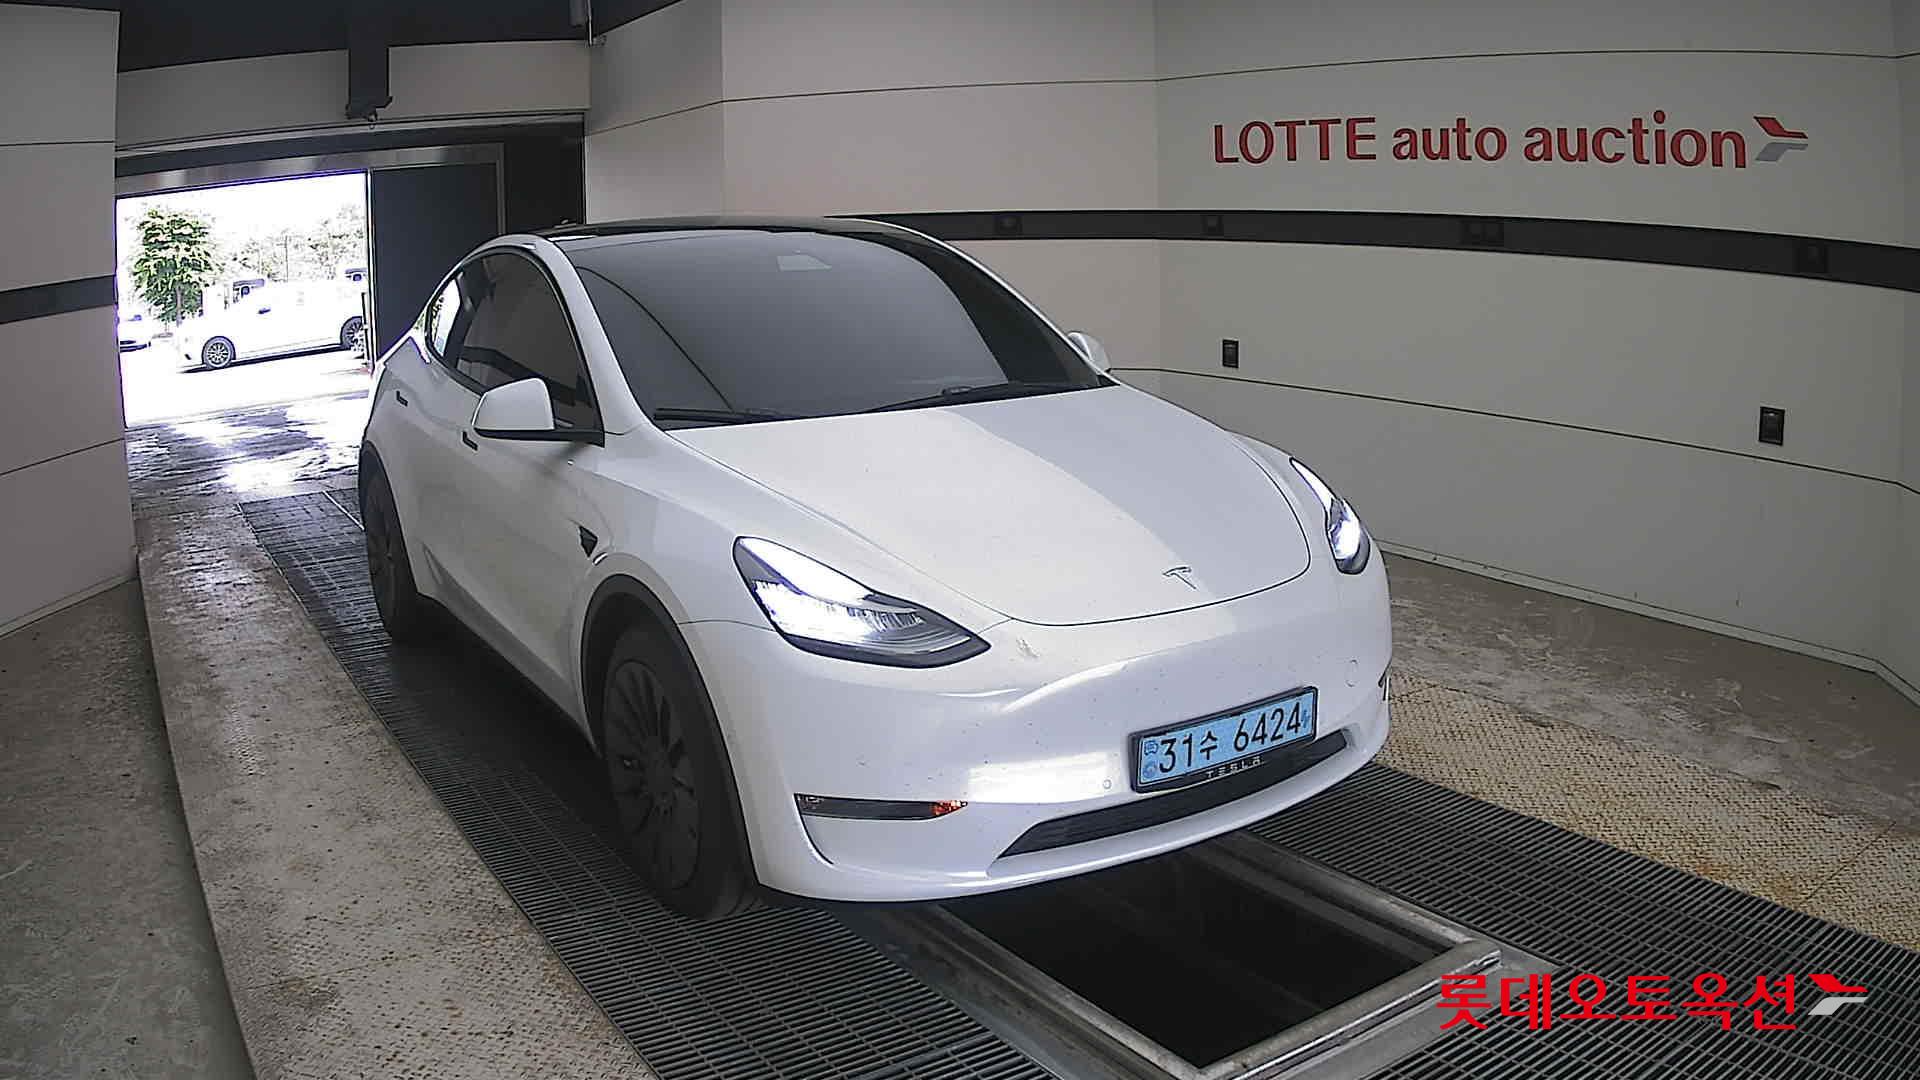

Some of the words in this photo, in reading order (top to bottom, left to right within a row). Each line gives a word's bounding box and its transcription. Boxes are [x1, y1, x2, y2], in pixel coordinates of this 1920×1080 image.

[1214, 117, 1377, 164] LOTTE
[1391, 117, 1507, 161] auto
[1523, 110, 1747, 169] auction
[1158, 730, 1218, 774] 31수
[1233, 702, 1301, 752] 6424
[1205, 755, 1262, 779] TESLA
